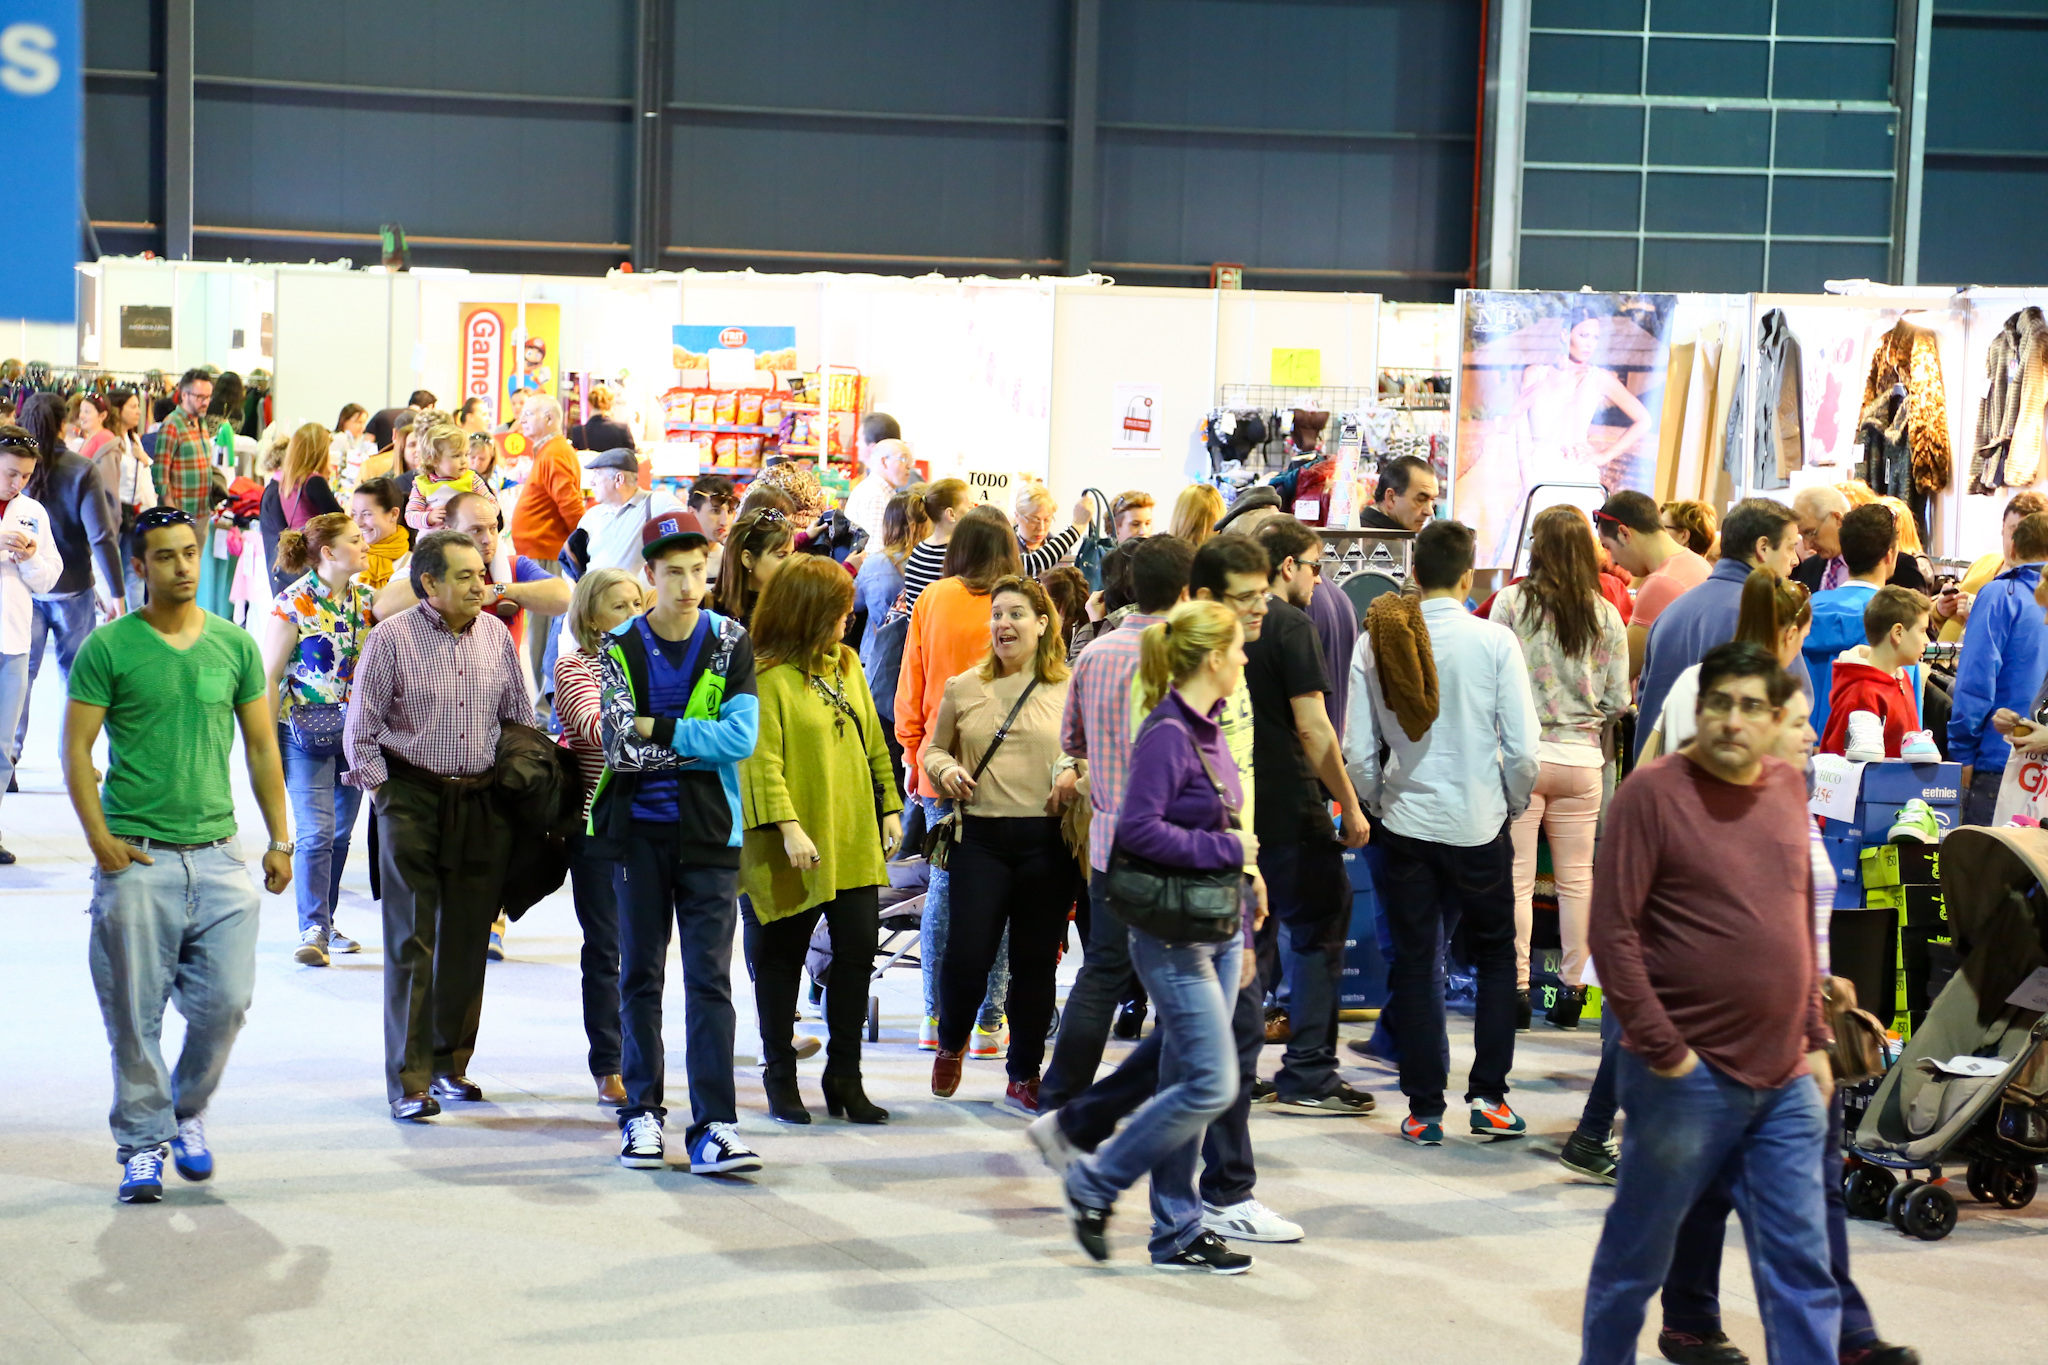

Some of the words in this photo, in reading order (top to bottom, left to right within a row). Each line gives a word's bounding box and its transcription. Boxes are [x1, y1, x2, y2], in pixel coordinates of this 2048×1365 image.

[471, 319, 495, 395] Game
[969, 472, 1008, 488] TODO
[979, 490, 988, 501] A
[1929, 787, 1957, 798] etnies
